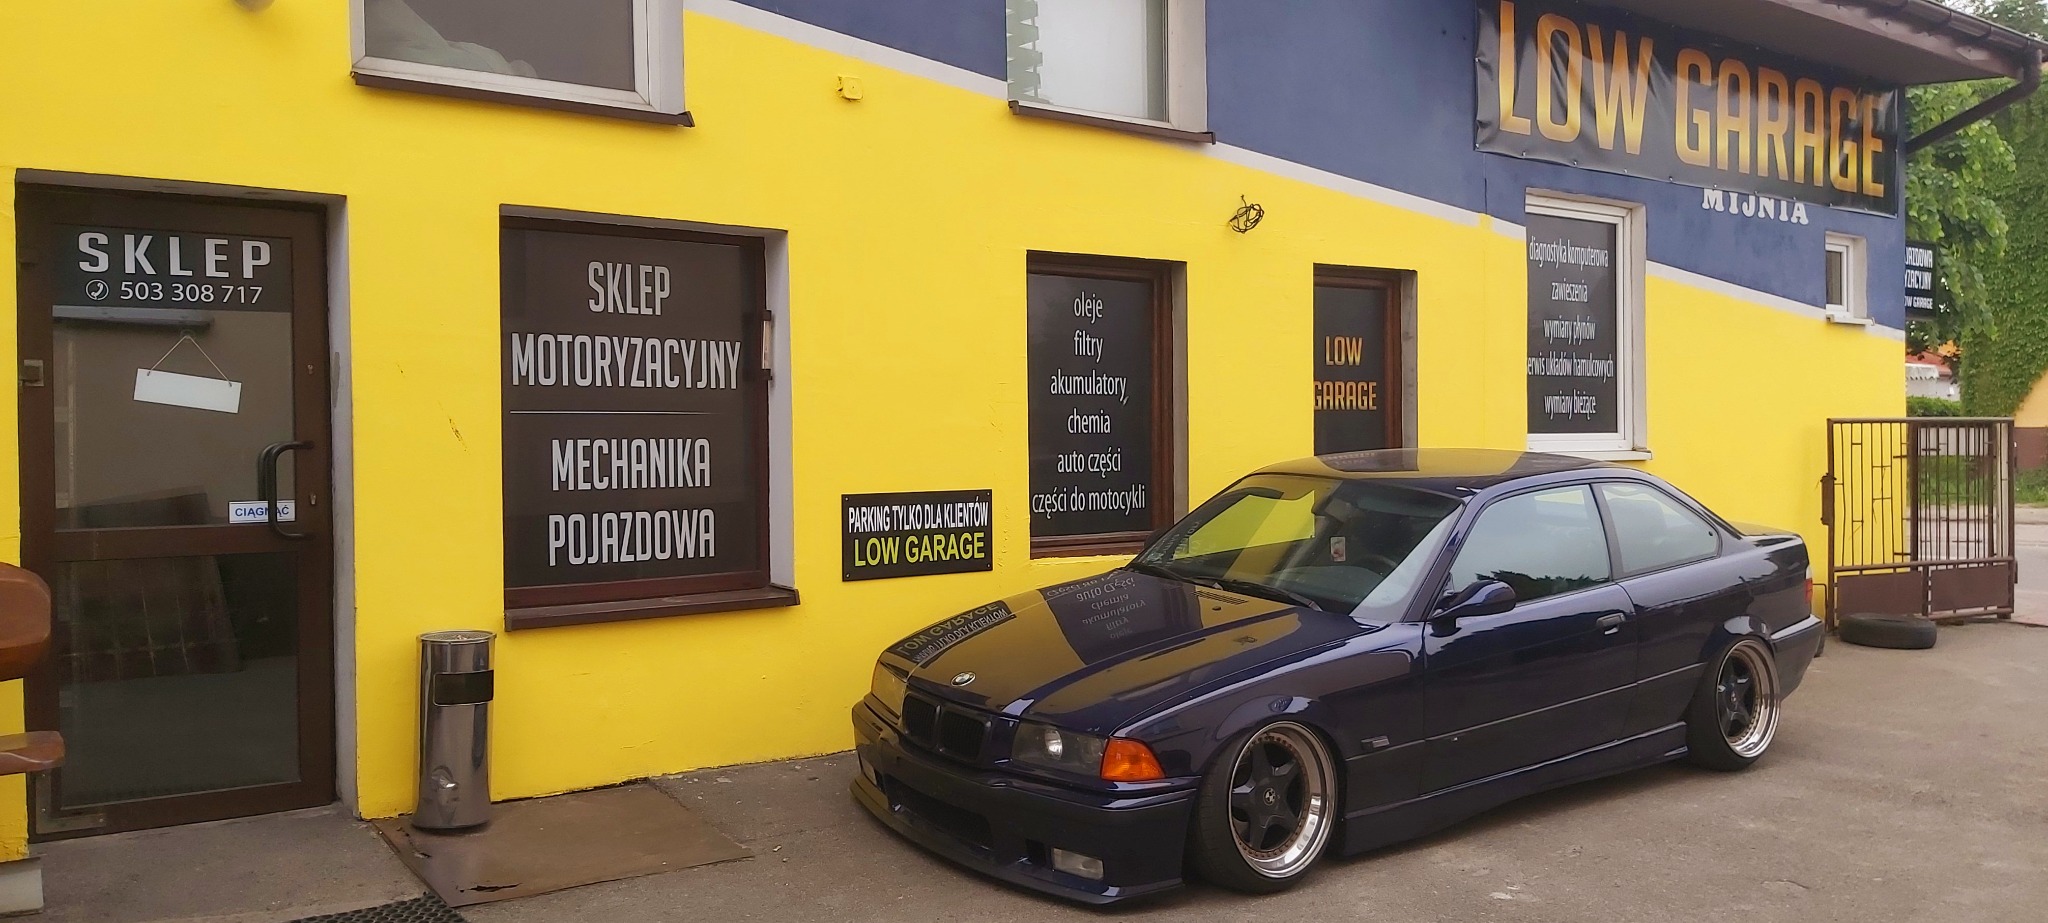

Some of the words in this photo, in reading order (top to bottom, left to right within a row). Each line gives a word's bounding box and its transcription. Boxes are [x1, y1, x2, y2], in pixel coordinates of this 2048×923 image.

[1498, 1, 1654, 156] LOW
[1675, 47, 1885, 198] GARAGE
[77, 231, 272, 279] SKLEP
[1529, 236, 1566, 270] diagnostyka
[1567, 239, 1609, 271] komputerowa
[120, 281, 164, 301] 503
[171, 283, 215, 302] 308
[221, 285, 263, 304] 717
[588, 261, 671, 316] SKLEP
[1551, 278, 1588, 303] zawieszenia
[1913, 296, 1933, 310] GARAGE
[1074, 291, 1103, 324] oleje
[1074, 329, 1103, 363] filtry
[1543, 317, 1572, 345] wymiany
[1573, 315, 1596, 345] płynów
[511, 332, 741, 390] MOTORYZACYJNY
[1325, 335, 1363, 366] LOW
[1545, 351, 1573, 376] układów
[1573, 352, 1614, 383] hamulcowych
[1050, 368, 1127, 402] akumulatory
[1313, 381, 1377, 411] GARAGE
[1067, 408, 1111, 434] chemia
[1544, 391, 1573, 420] wymiany
[1573, 389, 1597, 420] bieżące
[551, 438, 711, 491] MECHANIKA
[1057, 452, 1085, 473] auto
[1087, 448, 1122, 479] części
[848, 506, 891, 533] PARKING
[892, 504, 923, 531] TYLKO
[924, 503, 943, 529] DLA
[943, 495, 989, 528] KLIENTÓW
[1032, 488, 1067, 520] części
[1070, 487, 1086, 513] do
[1088, 483, 1146, 516] motocykli
[548, 508, 715, 567] POJAZDOWA
[854, 536, 900, 567] LOW
[905, 532, 985, 564] GARAGE
